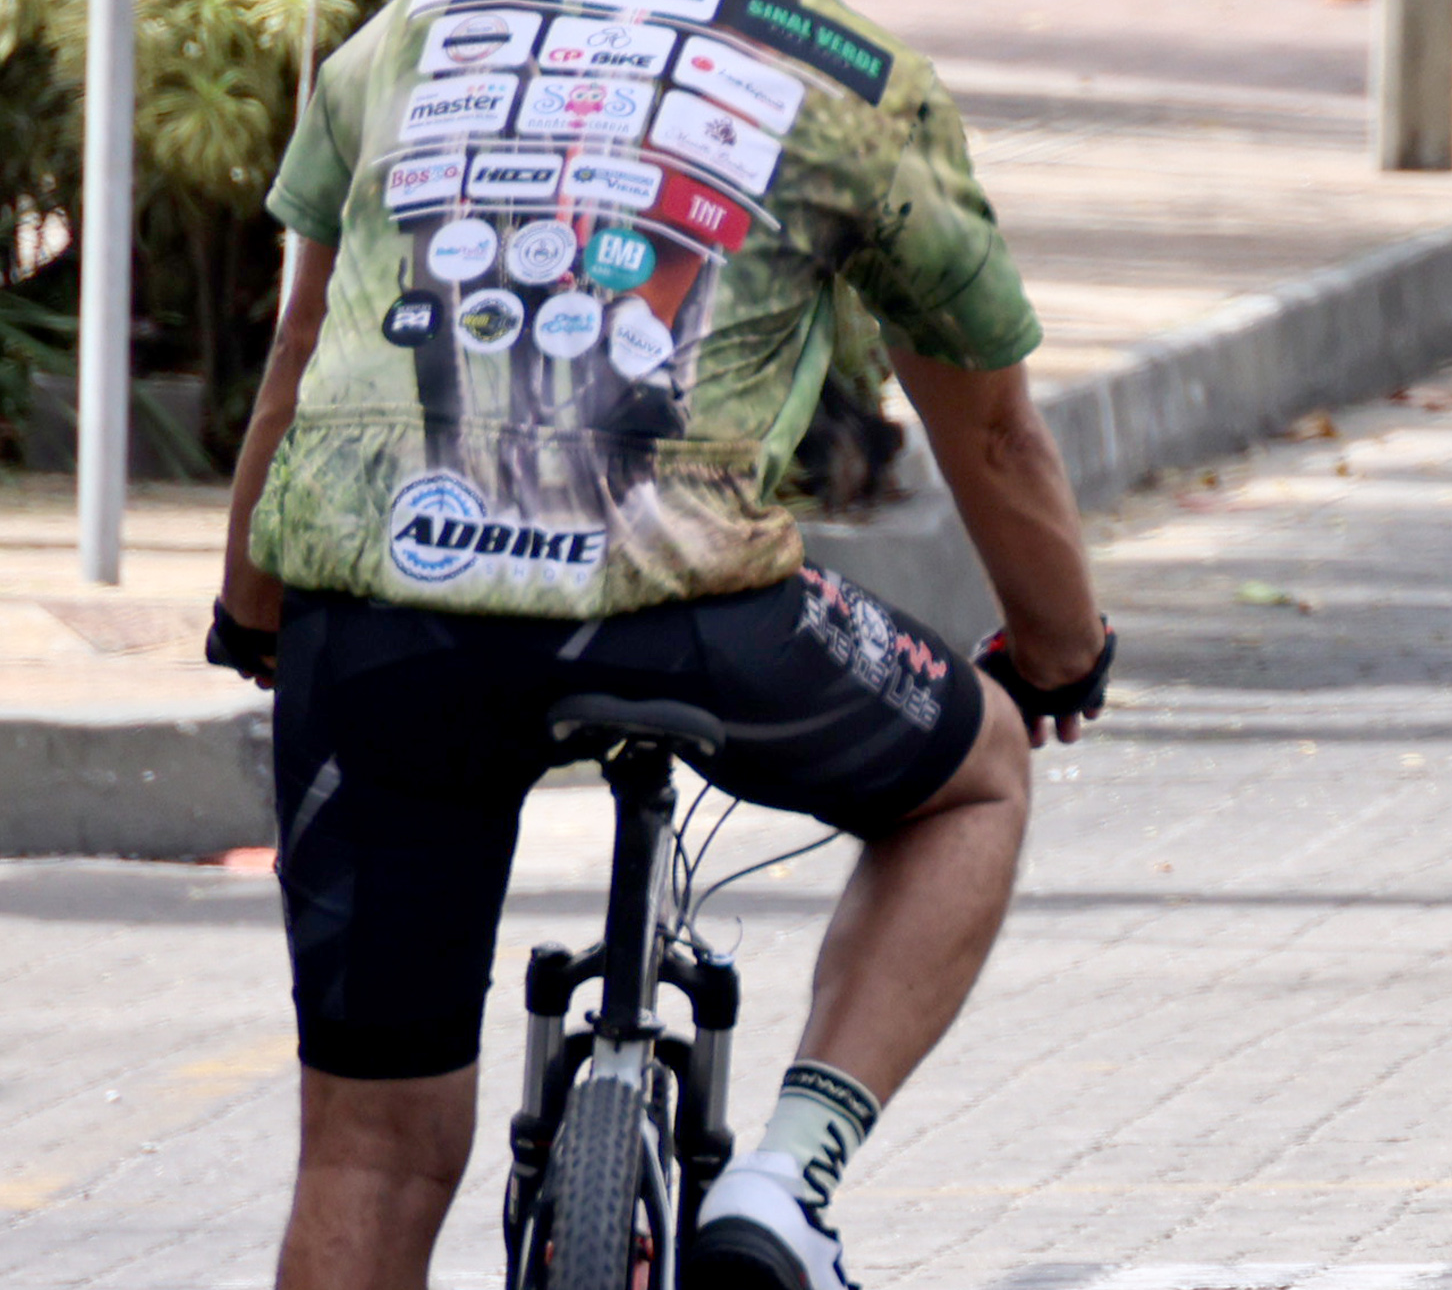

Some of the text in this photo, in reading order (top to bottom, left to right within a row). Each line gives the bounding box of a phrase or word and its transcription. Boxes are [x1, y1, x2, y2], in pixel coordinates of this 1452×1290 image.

[590, 50, 657, 68] BIKE
[815, 26, 884, 79] VERDE
[409, 93, 503, 122] master
[688, 194, 727, 231] TNT
[394, 513, 606, 564] ADBIKE
[485, 563, 587, 584] SHOP
